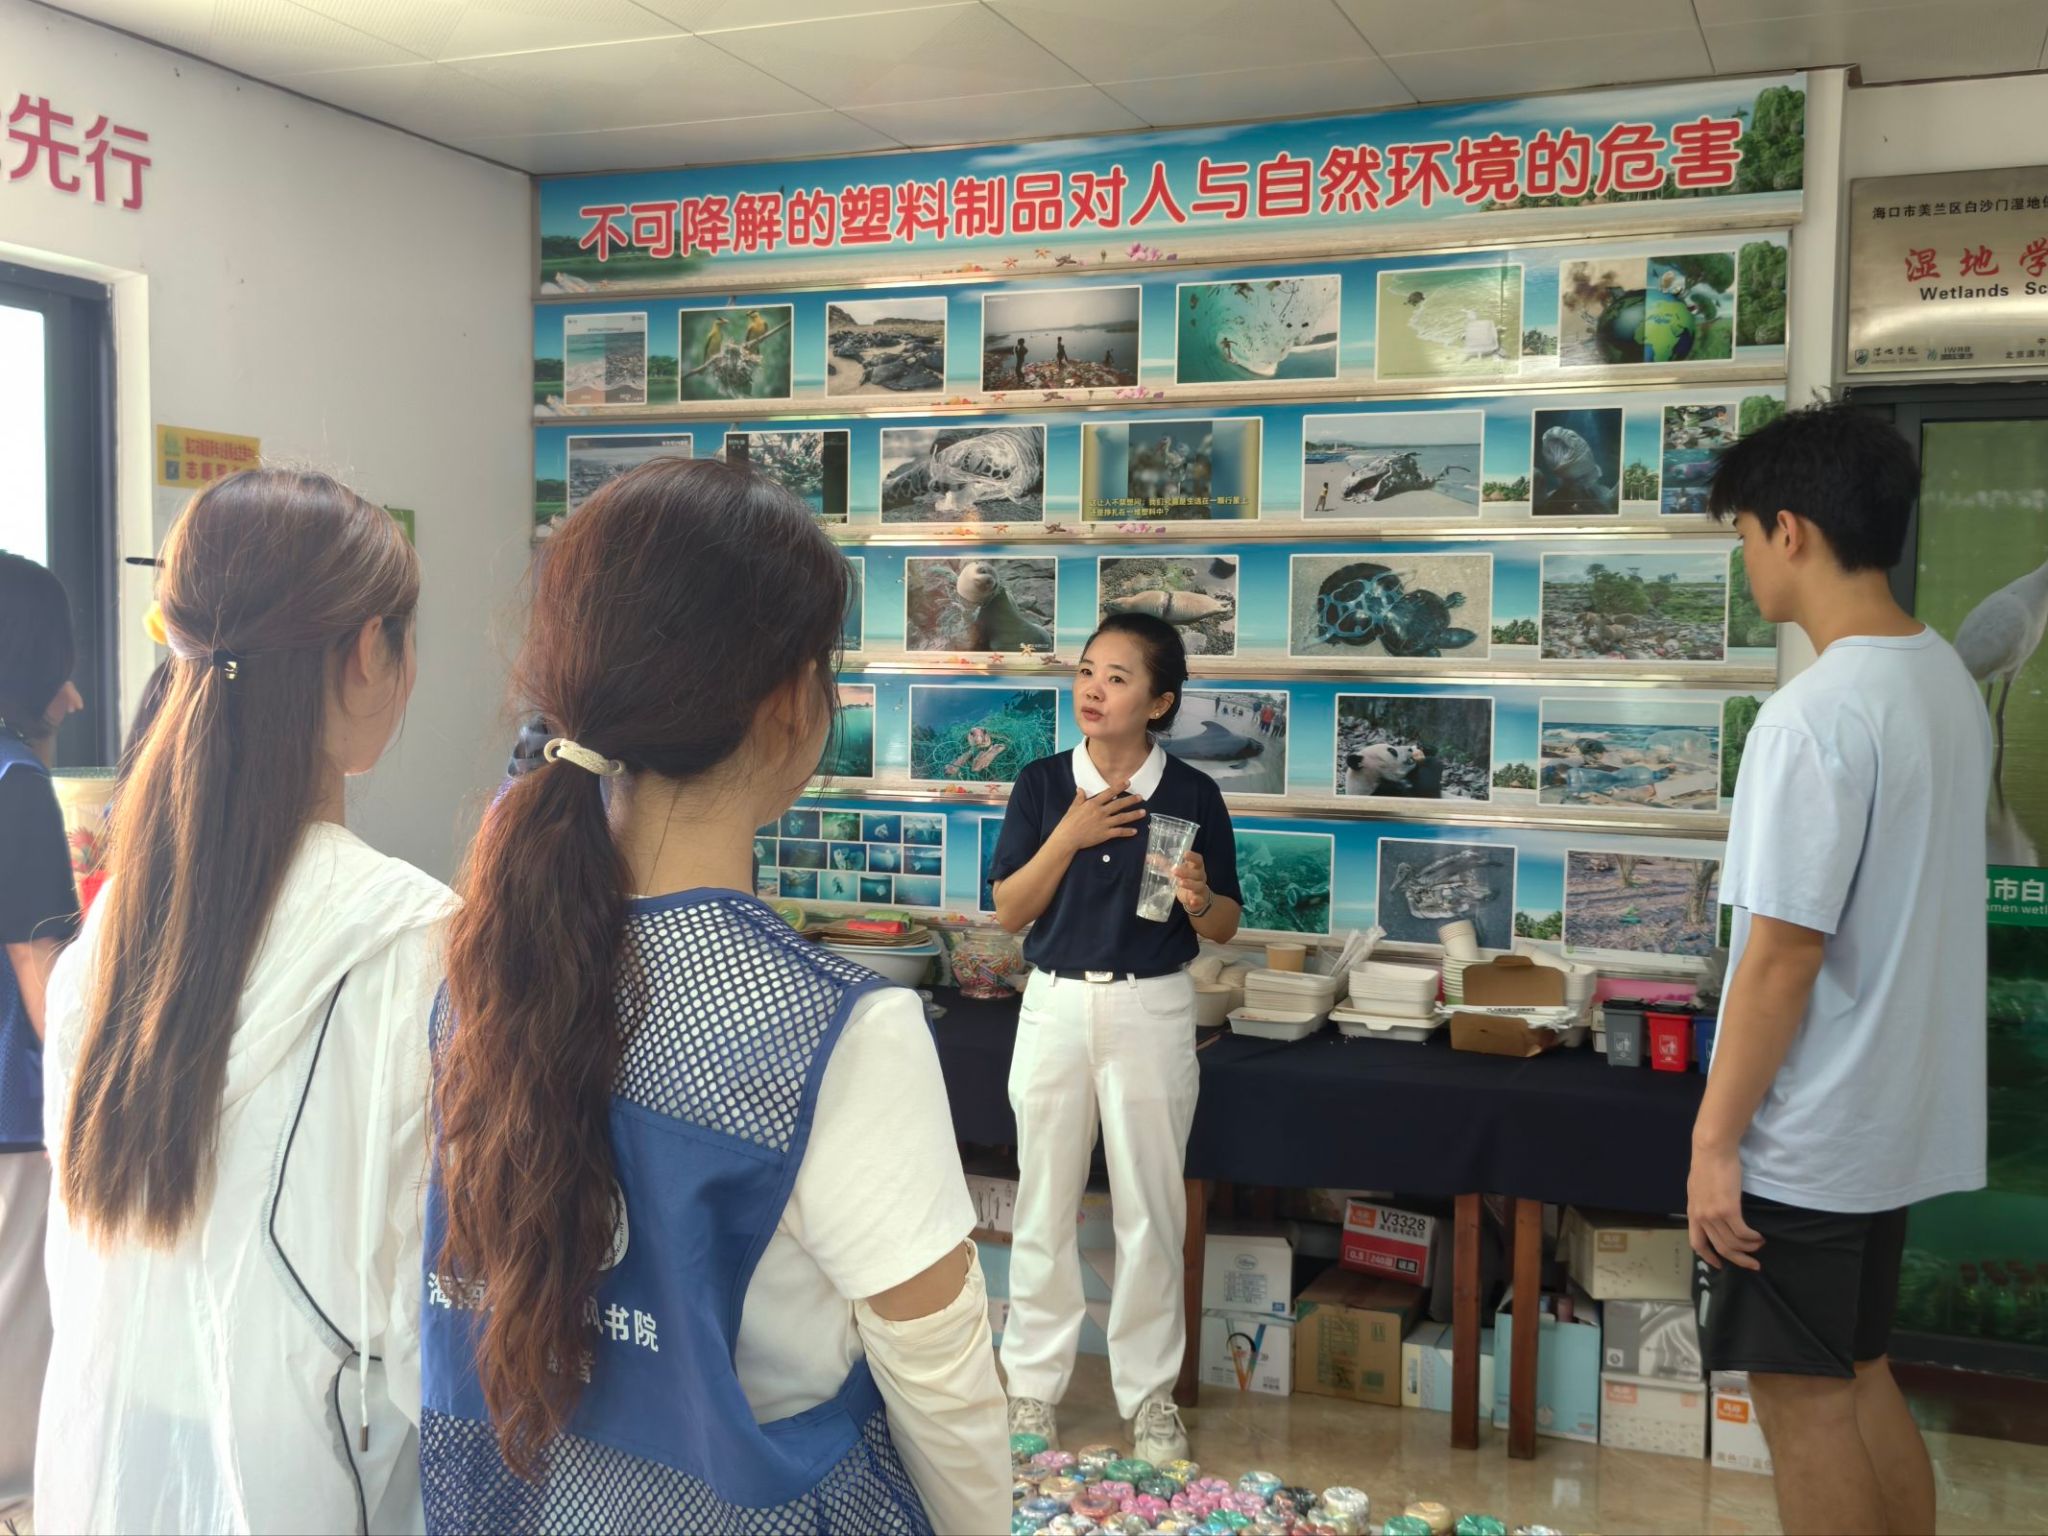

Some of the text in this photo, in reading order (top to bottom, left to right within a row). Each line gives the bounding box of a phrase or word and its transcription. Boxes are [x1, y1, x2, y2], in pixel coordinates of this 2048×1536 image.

[0, 93, 152, 210] 先行
[580, 117, 1743, 262] 不可降解的塑料制品对人与自然环境的危害
[1920, 284, 2009, 301] Wetlands
[1985, 877, 2045, 903] 市白
[1381, 1210, 1427, 1232] V3328
